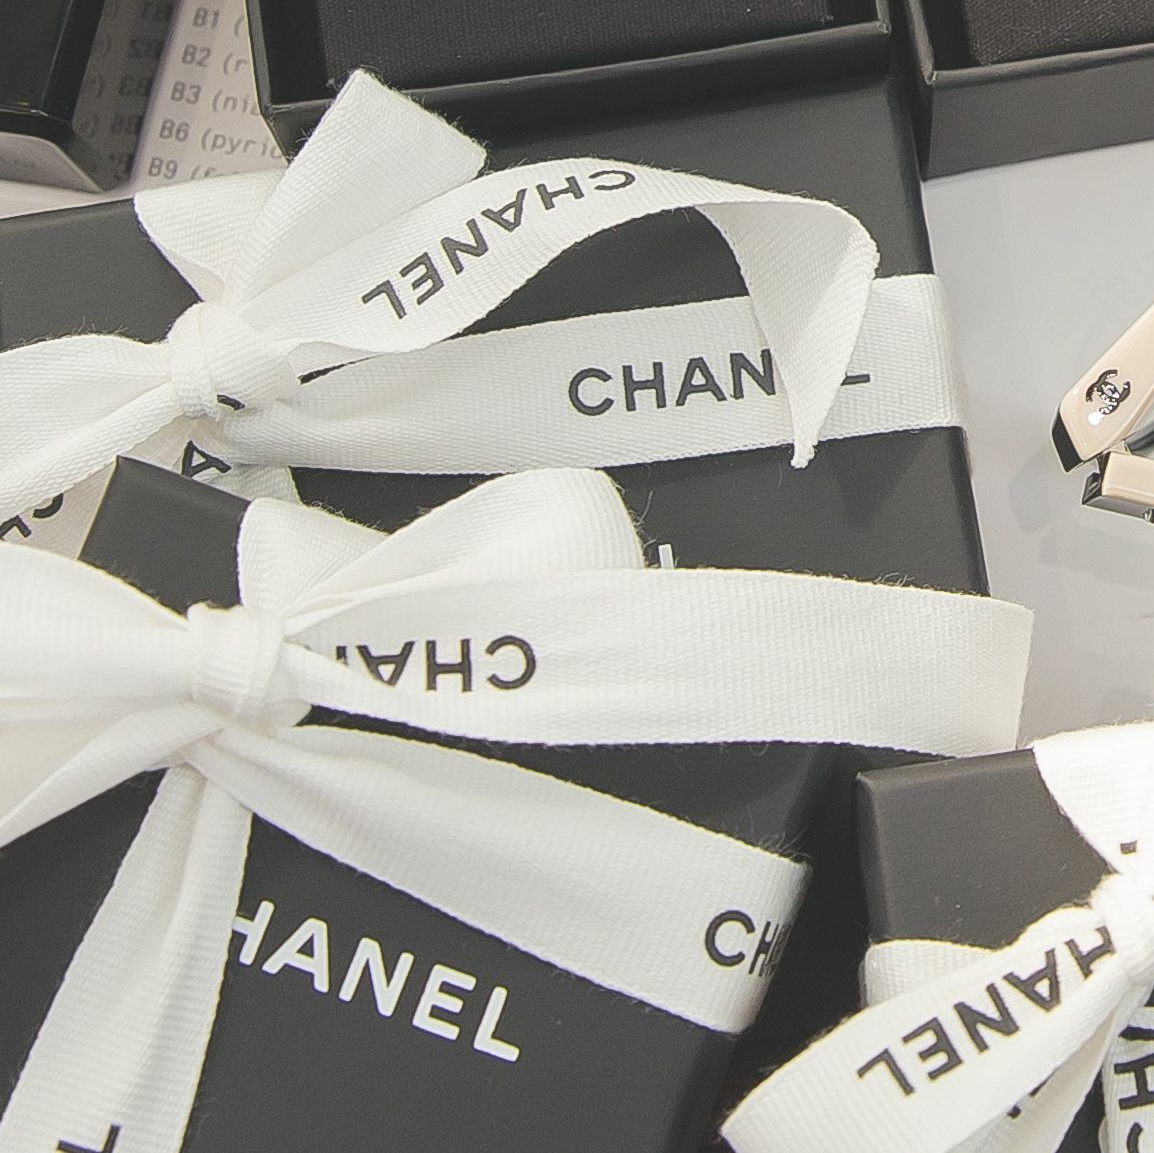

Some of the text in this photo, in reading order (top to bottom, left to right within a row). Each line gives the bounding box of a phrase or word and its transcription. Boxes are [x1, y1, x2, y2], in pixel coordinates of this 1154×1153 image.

[193, 6, 220, 29] B1
[181, 43, 212, 68] B2
[170, 81, 202, 106] B3
[158, 118, 190, 143] B6
[148, 156, 179, 180] B9
[361, 169, 636, 320] CHANEL
[568, 348, 871, 416] CHAN
[336, 635, 537, 693] CHA
[231, 899, 520, 1063] HANEL
[857, 926, 1117, 1097] HANEL
